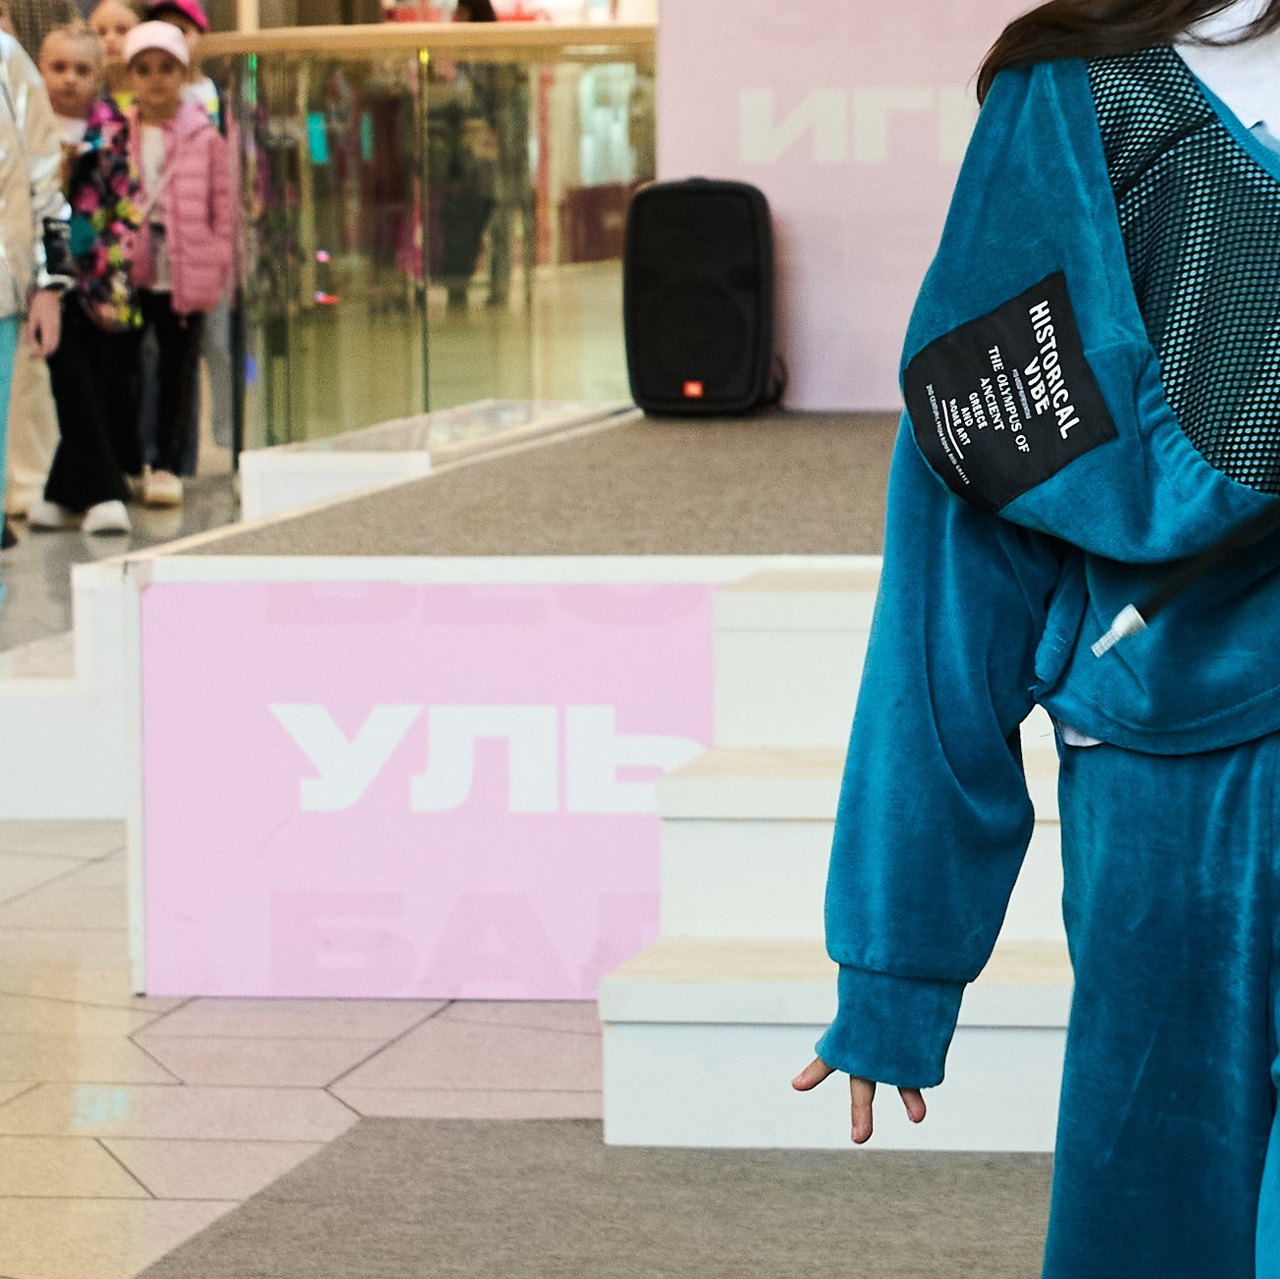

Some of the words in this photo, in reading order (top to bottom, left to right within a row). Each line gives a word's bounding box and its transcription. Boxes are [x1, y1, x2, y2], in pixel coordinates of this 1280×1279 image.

[988, 345, 1005, 373] THE
[1028, 300, 1081, 440] HISTORICAL
[979, 377, 1005, 432] ANCIENT
[996, 373, 1023, 433] OLYMPUS
[1024, 356, 1050, 416] VIBE
[949, 398, 962, 427] ROME
[956, 427, 972, 446] ART
[960, 406, 974, 427] AND
[968, 392, 989, 431] GREECE
[1014, 434, 1030, 454] OF
